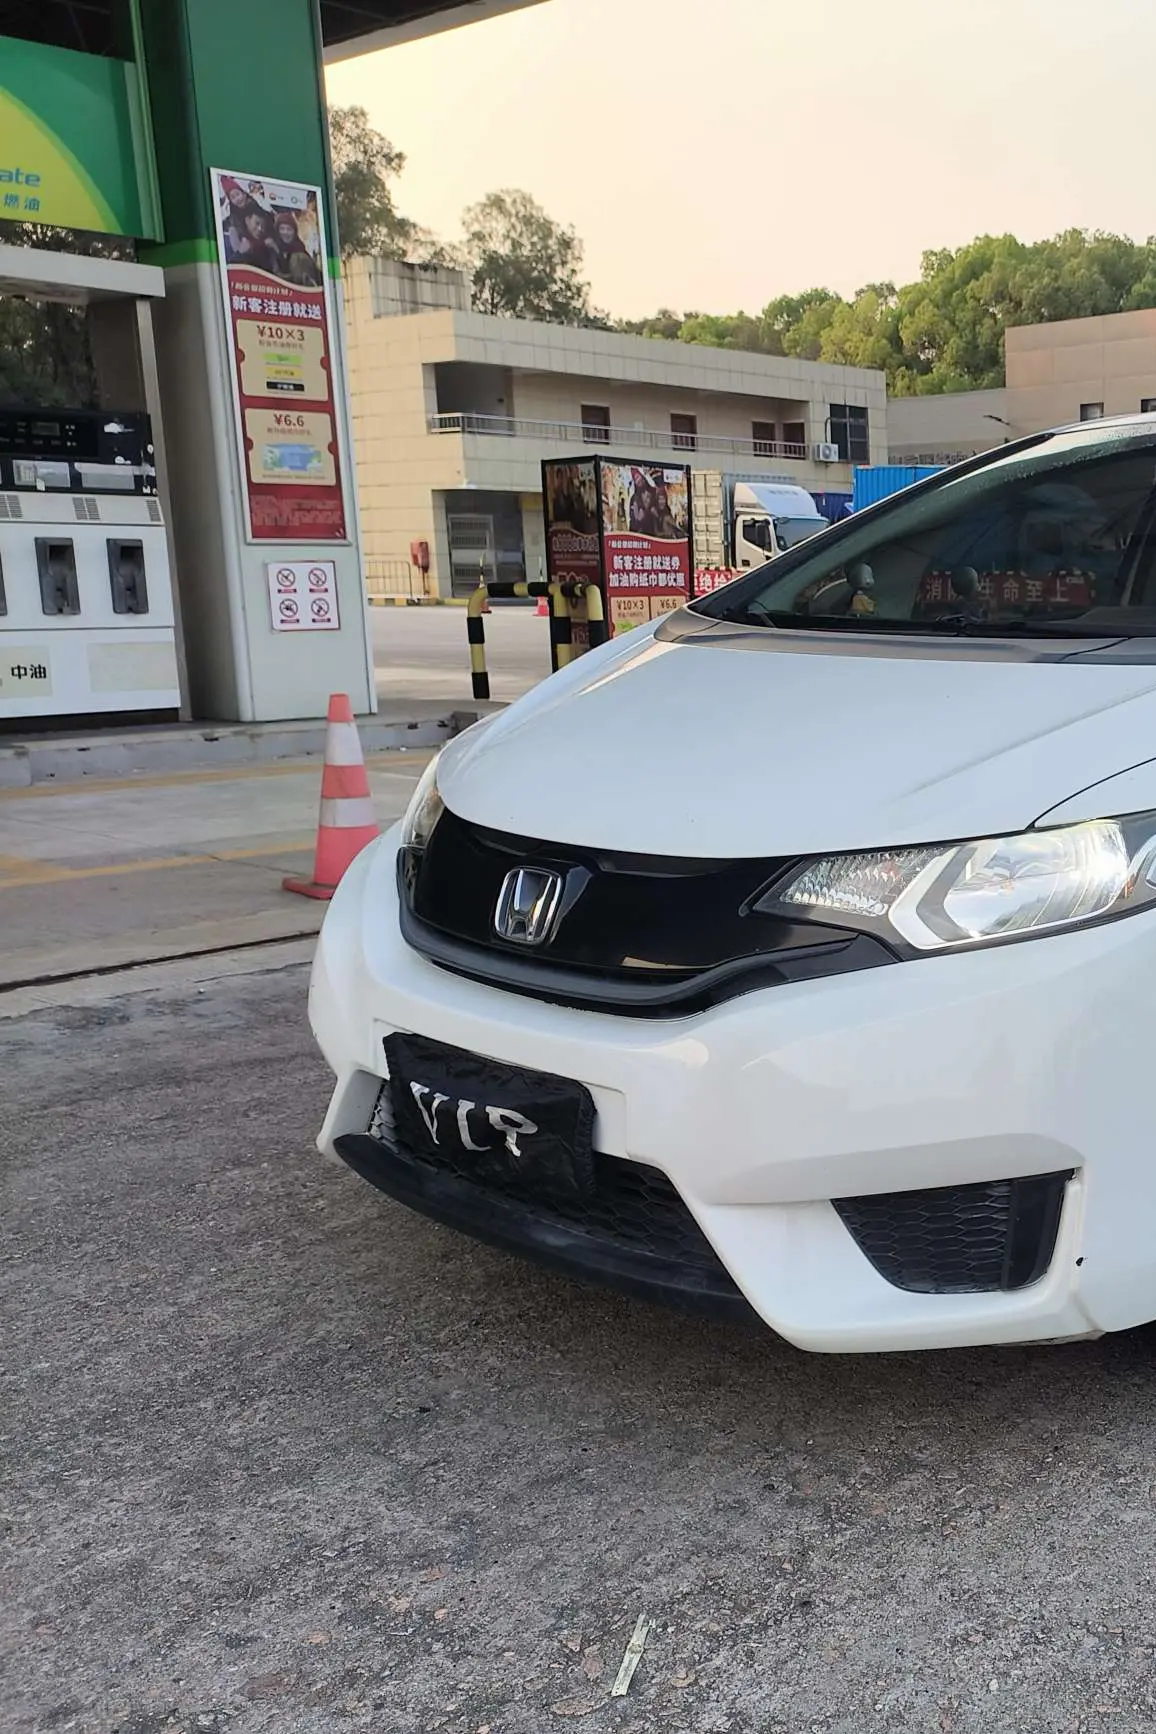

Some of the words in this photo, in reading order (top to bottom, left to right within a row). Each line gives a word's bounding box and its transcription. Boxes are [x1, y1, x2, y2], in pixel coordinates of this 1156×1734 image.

[232, 295, 322, 319] 新客注册就送
[273, 413, 305, 427] ¥6.6
[613, 555, 680, 570] 新客注册就送券
[11, 664, 47, 680] 中油
